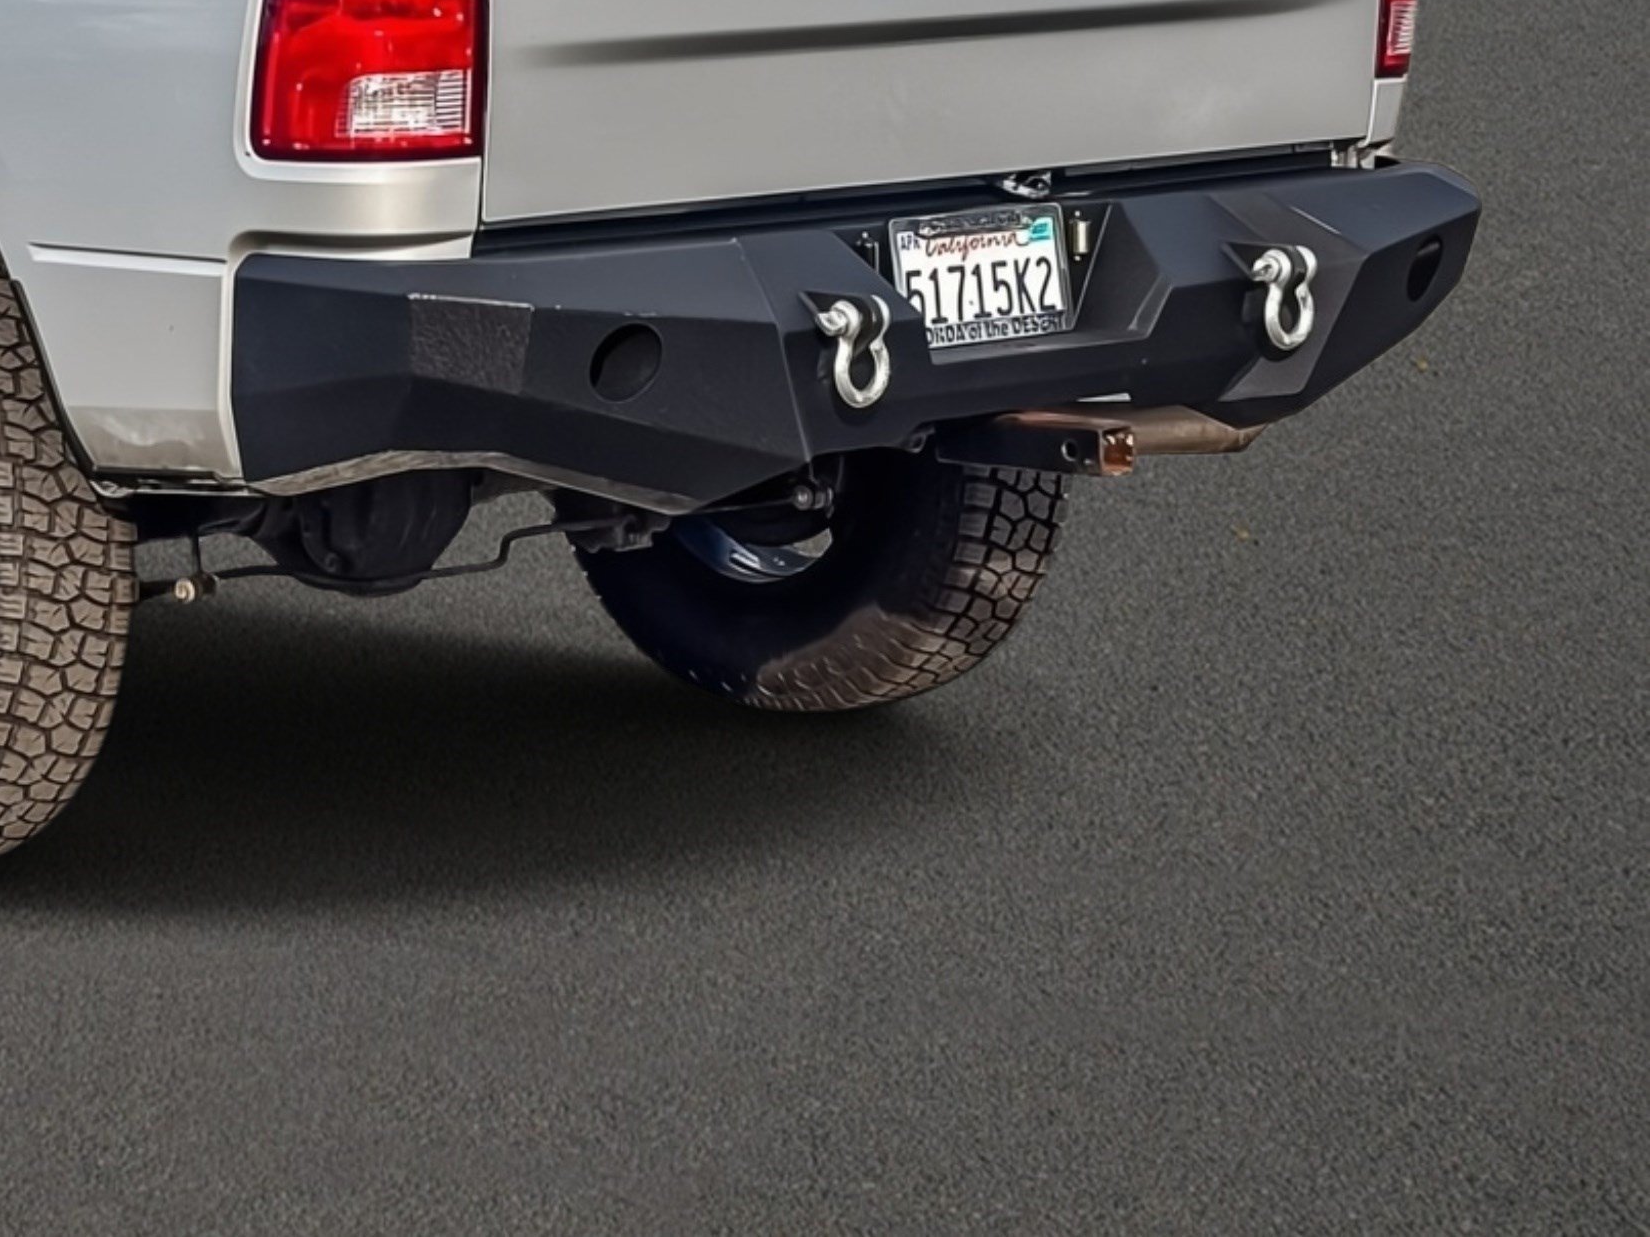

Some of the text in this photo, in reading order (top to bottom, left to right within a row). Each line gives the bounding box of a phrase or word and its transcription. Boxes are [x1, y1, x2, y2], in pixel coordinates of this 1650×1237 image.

[925, 231, 1030, 261] California
[905, 256, 1056, 324] 51715K2
[985, 319, 1009, 338] the
